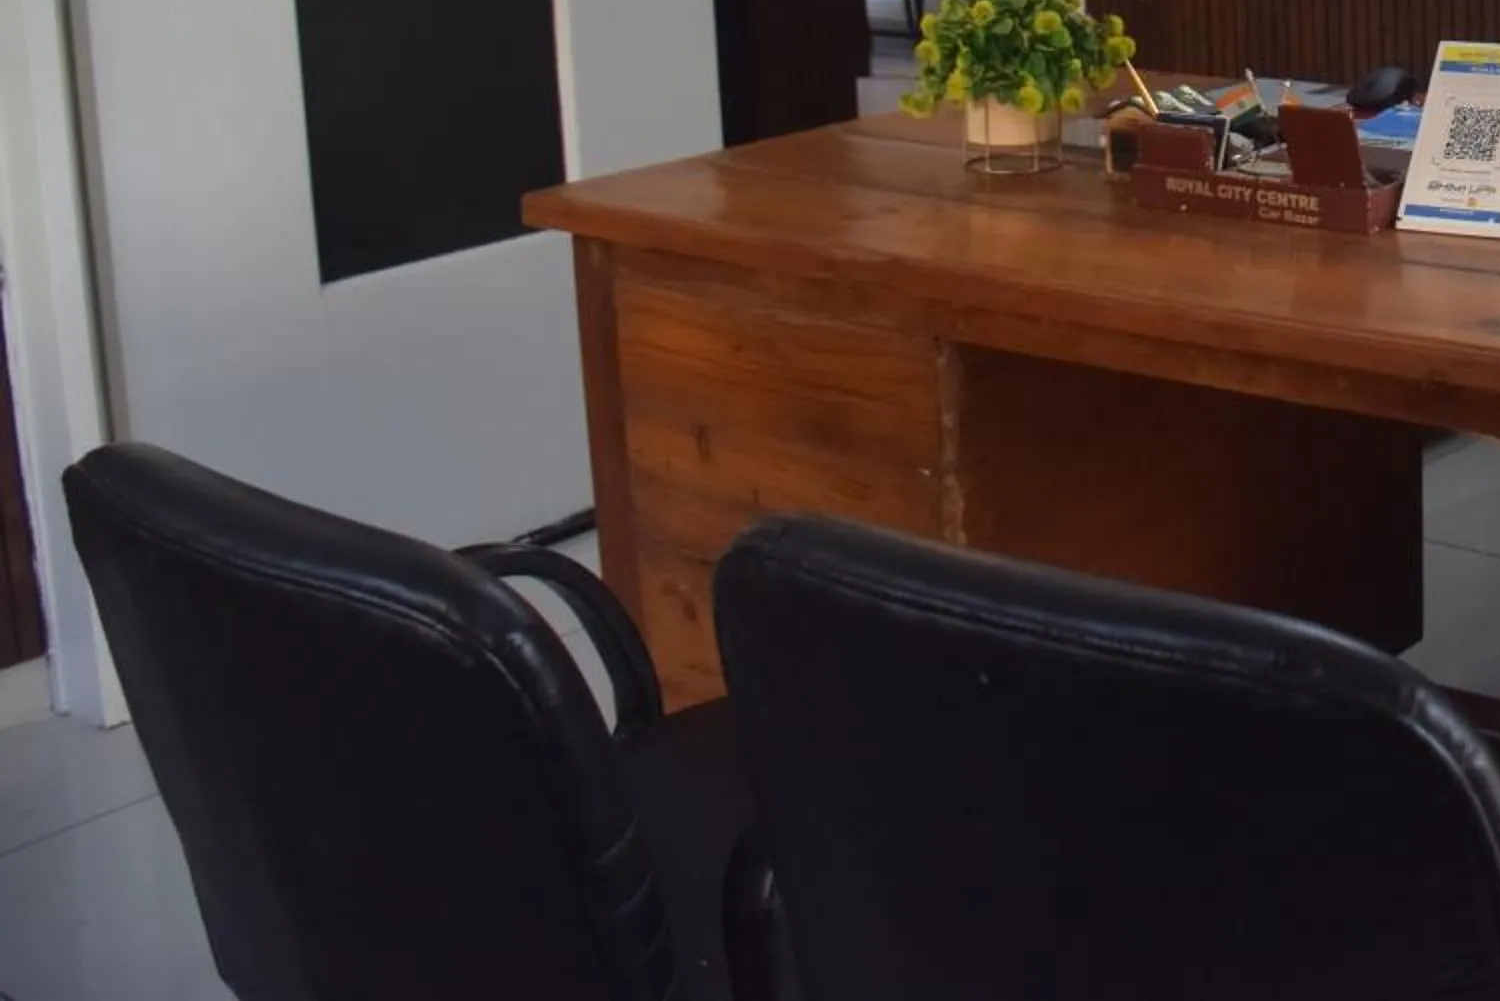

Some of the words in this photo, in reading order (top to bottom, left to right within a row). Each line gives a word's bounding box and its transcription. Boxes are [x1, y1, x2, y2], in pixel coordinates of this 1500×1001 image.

[1166, 176, 1214, 197] ROYAL
[1217, 184, 1254, 203] CITY
[1256, 190, 1320, 211] CENTRE
[1258, 207, 1281, 219] Car
